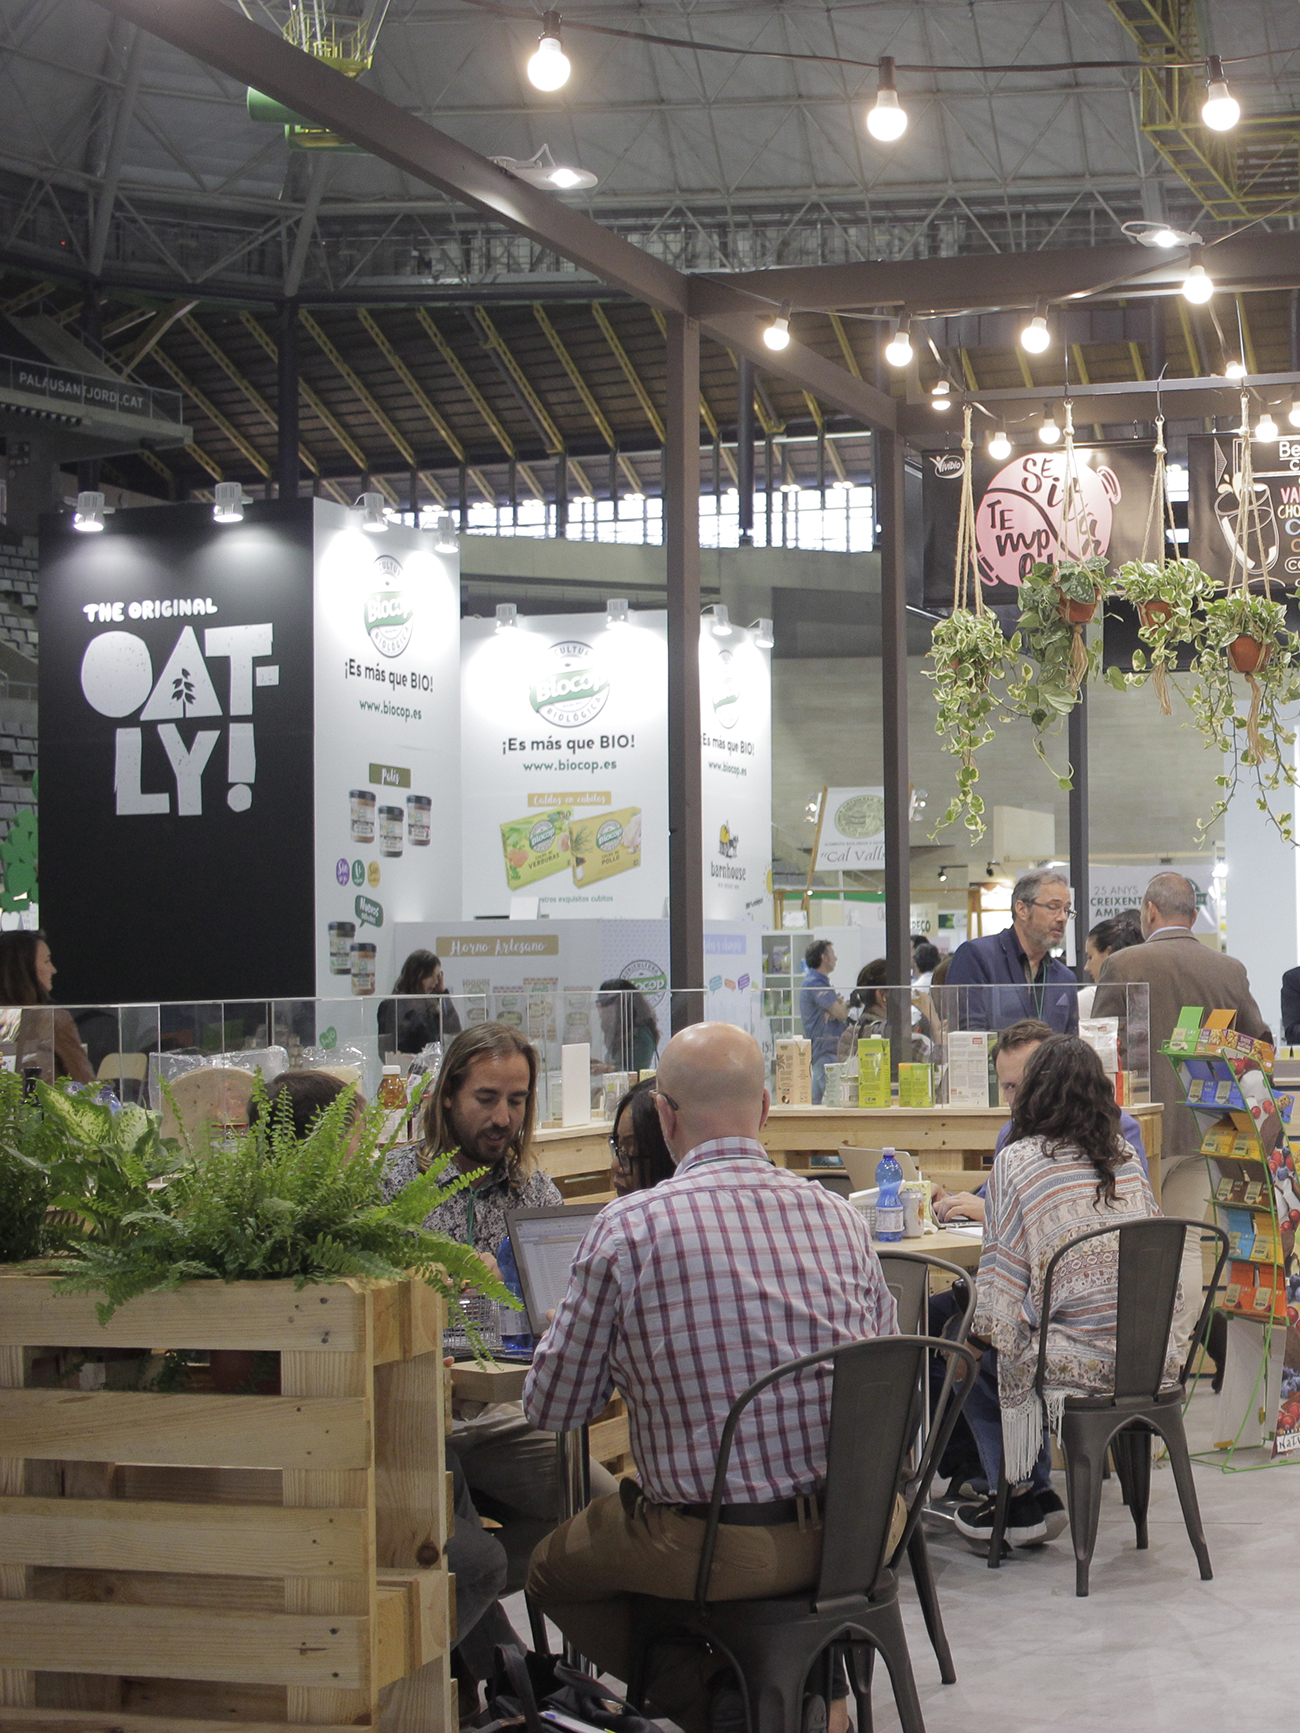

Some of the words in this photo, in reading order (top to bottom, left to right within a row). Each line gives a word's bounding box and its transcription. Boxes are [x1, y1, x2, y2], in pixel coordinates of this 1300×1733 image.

[82, 602, 125, 622] THE
[128, 598, 218, 620] ORIGINAL
[365, 662, 386, 683] más
[389, 671, 408, 691] que
[411, 672, 433, 693] BIO!
[359, 699, 422, 723] www.biocop.es
[531, 735, 562, 751] más
[566, 738, 595, 755] que
[600, 734, 635, 749] BIO!
[727, 741, 739, 756] que
[114, 723, 256, 816] LY!
[523, 759, 617, 774] www.biocop.es
[601, 855, 620, 866] POLLO
[711, 861, 746, 882] barnhouse
[1094, 886, 1106, 896] 25
[1110, 885, 1139, 896] ANYS
[1090, 896, 1143, 907] CREIXENT
[450, 941, 490, 955] Horno
[495, 938, 548, 956] Artesano
